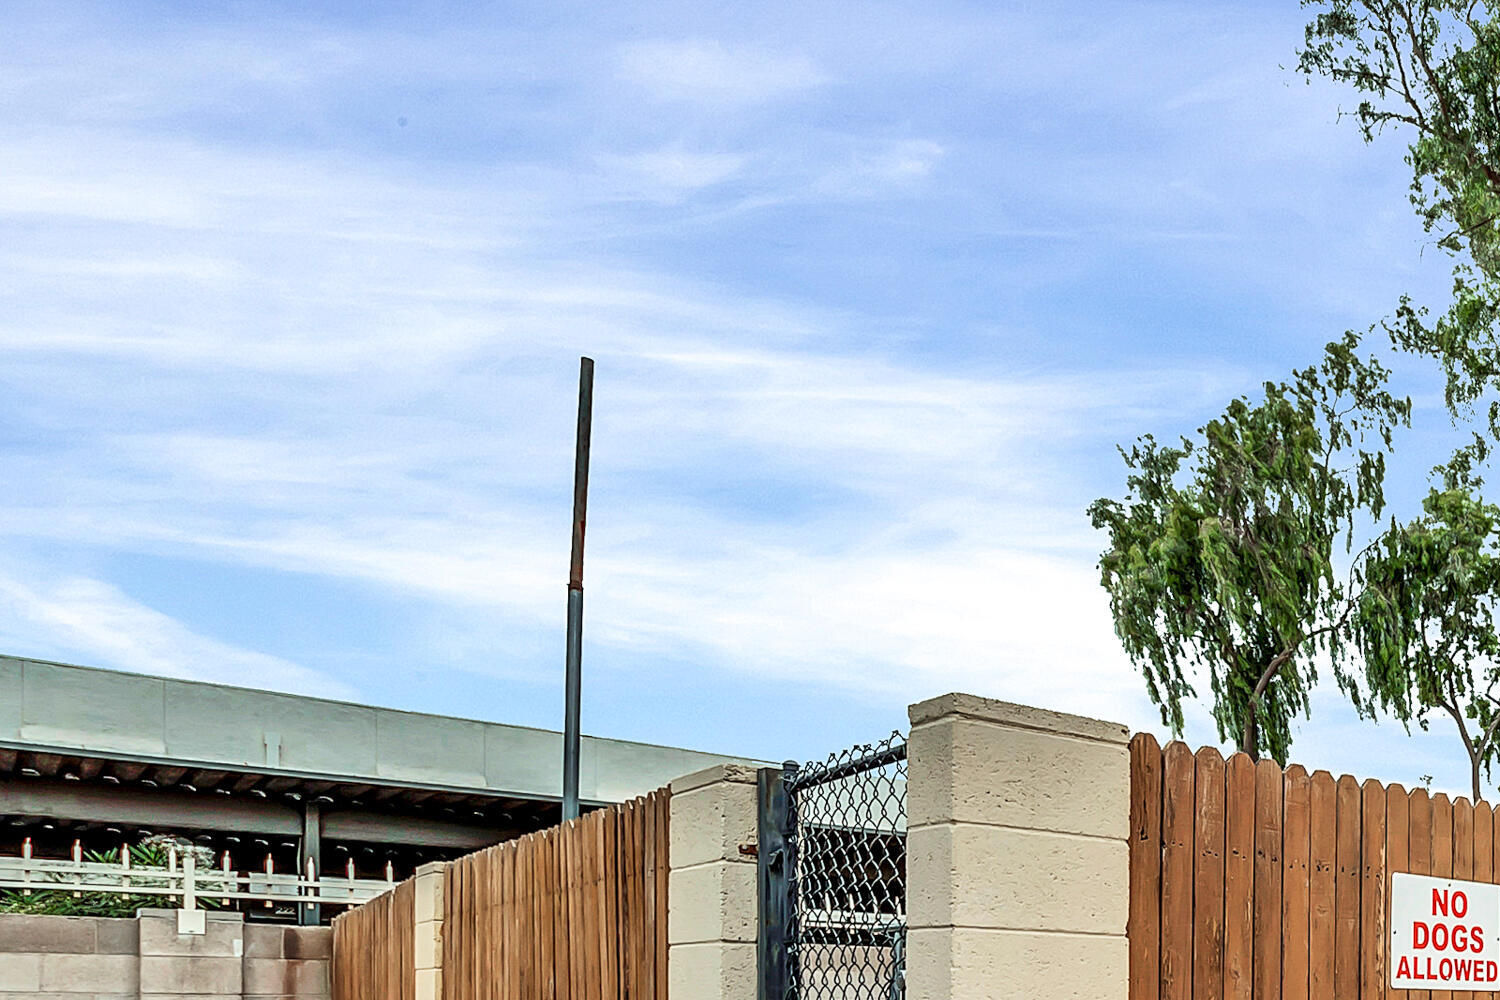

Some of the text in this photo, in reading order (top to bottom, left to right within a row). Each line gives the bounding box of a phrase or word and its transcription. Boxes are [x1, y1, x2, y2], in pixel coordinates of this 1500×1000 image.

[1432, 888, 1468, 918] NO
[1413, 921, 1484, 953] DOGS
[1396, 956, 1498, 982] ALLOWED
